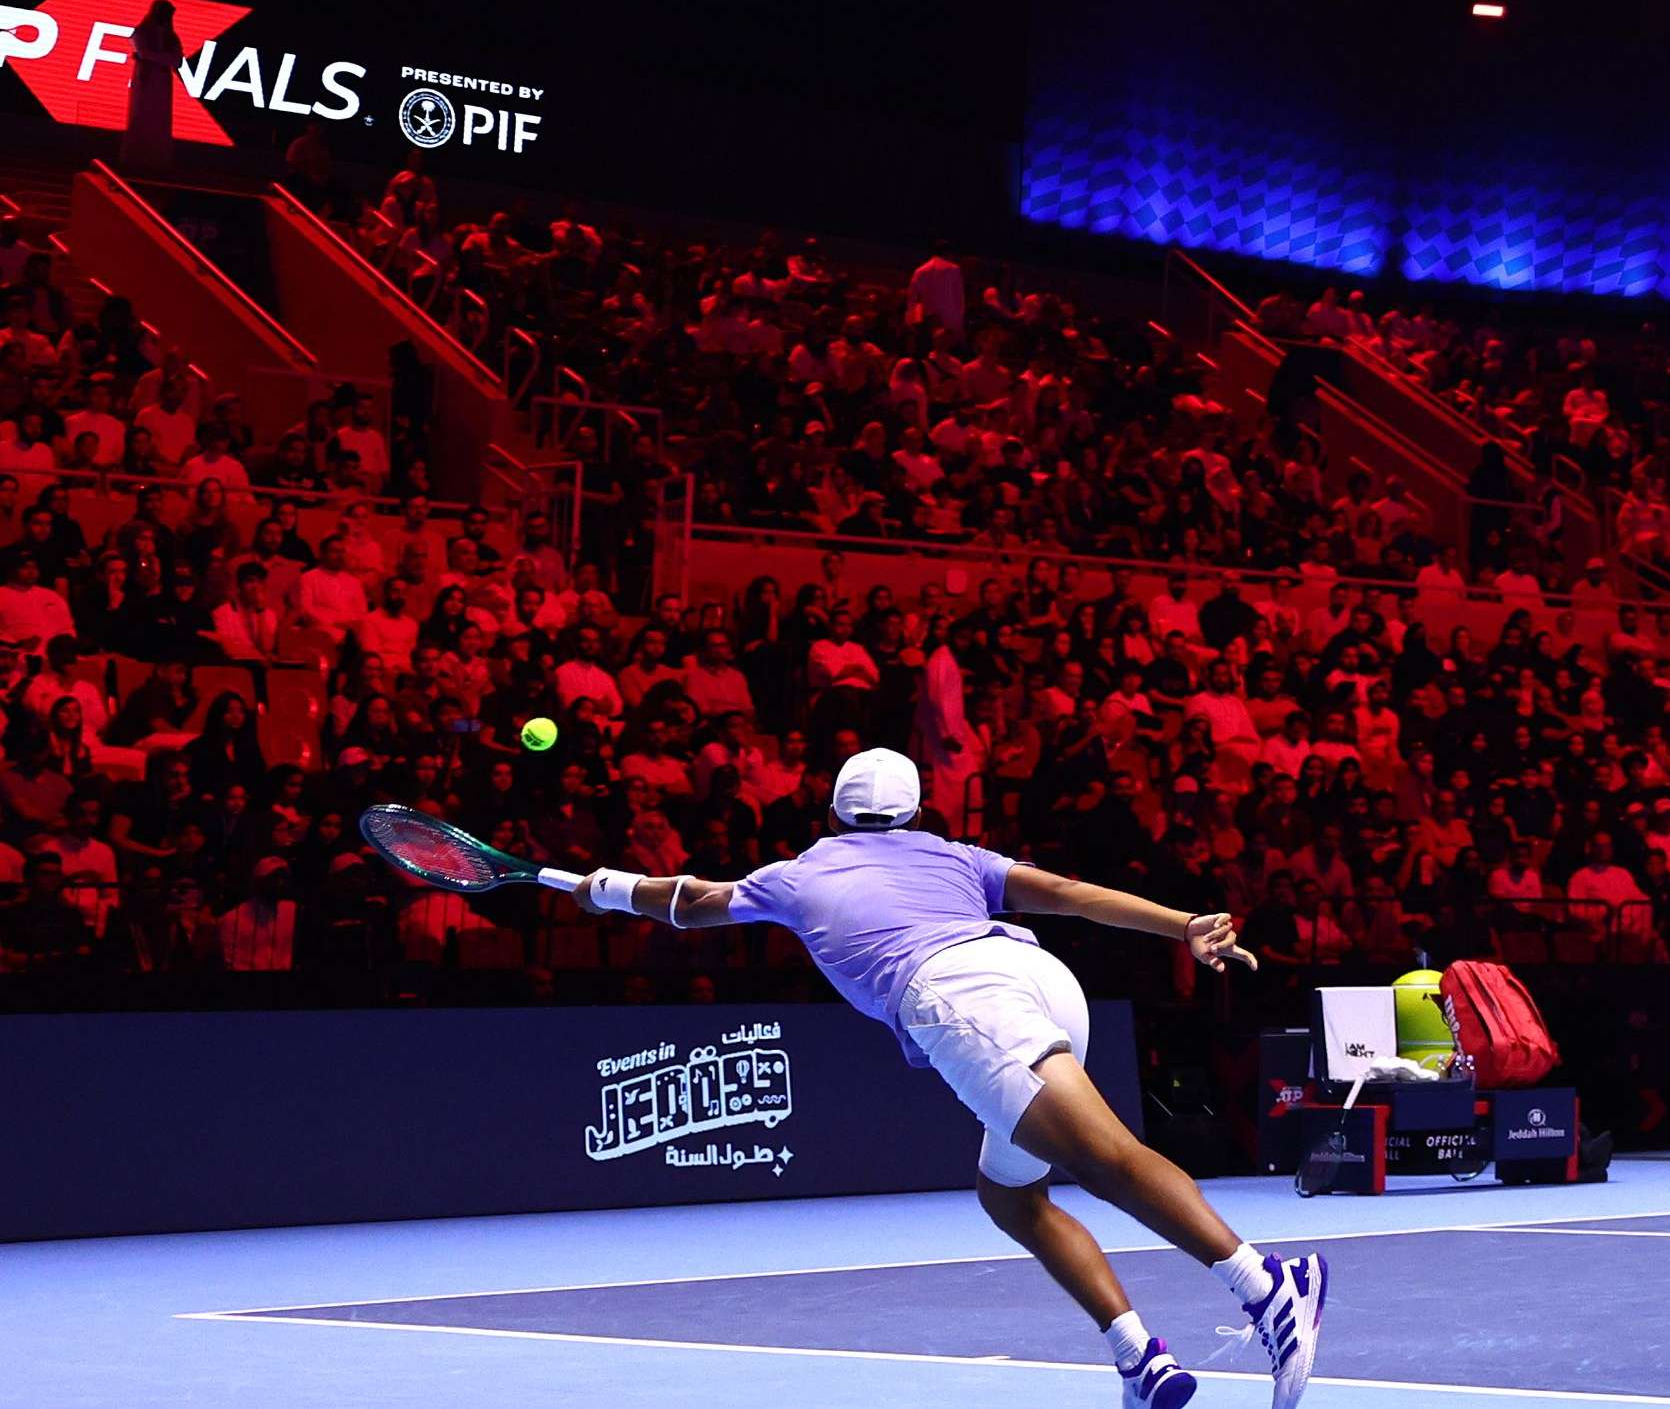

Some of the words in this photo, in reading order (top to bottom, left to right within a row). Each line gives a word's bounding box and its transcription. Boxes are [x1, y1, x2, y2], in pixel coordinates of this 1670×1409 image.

[77, 21, 367, 121] FNALS
[401, 66, 514, 95] PRESENTED
[518, 86, 544, 100] BY
[463, 104, 542, 153] PIF
[722, 1021, 782, 1044] فعاليات
[596, 1051, 656, 1077] Events
[657, 1042, 676, 1063] in
[665, 1144, 718, 1167] السنة
